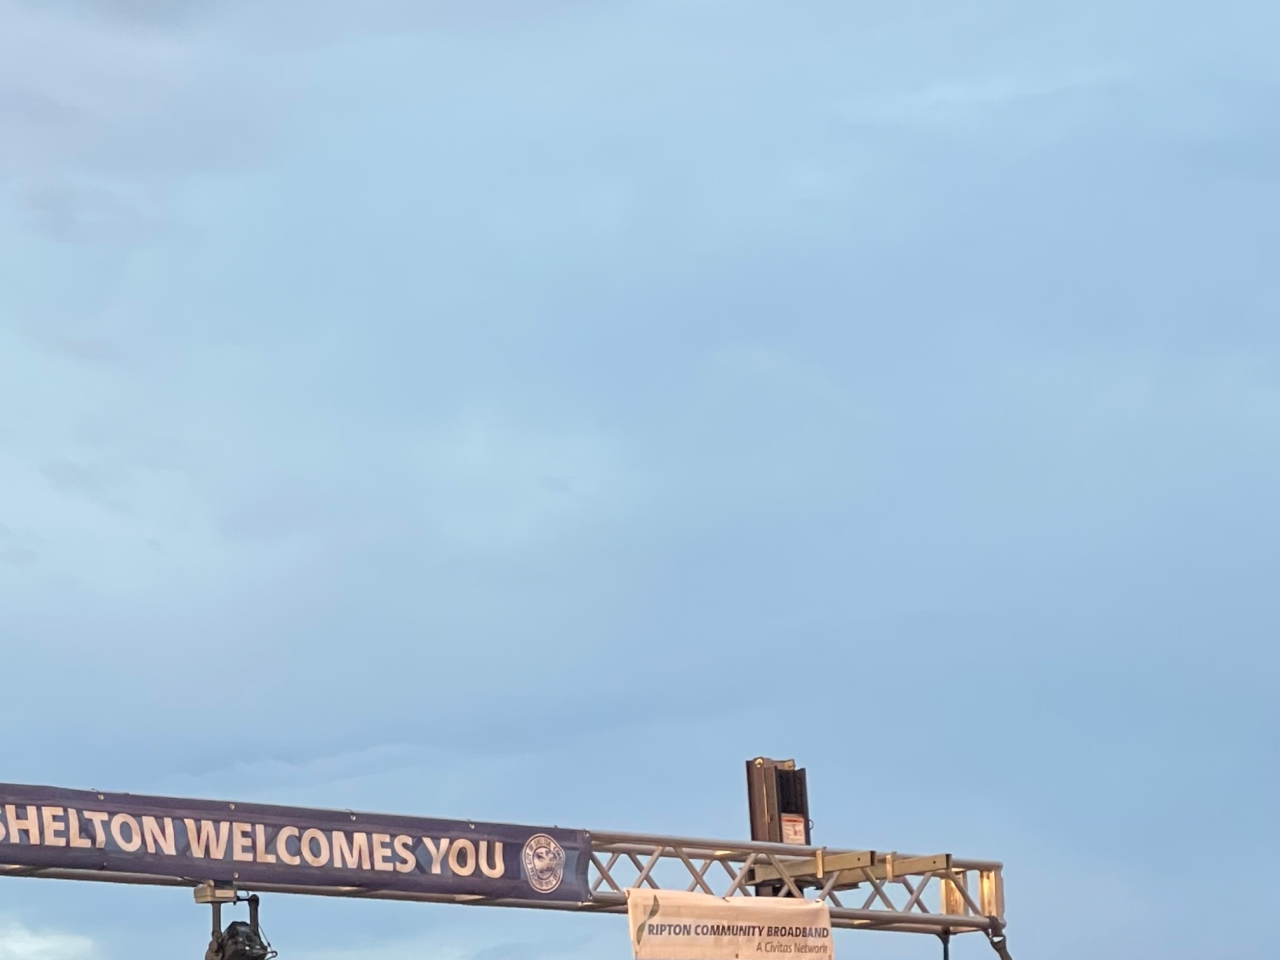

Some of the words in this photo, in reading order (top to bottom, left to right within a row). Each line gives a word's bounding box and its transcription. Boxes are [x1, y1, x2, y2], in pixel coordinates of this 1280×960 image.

[183, 818, 418, 874] WELCOMES
[421, 837, 506, 879] YOU
[648, 924, 692, 936] RIPTON
[694, 924, 765, 937] COMMUNITY
[766, 926, 830, 939] BROADBAND
[756, 942, 762, 952] A
[764, 942, 793, 953] Civitas
[794, 942, 828, 954] Network
